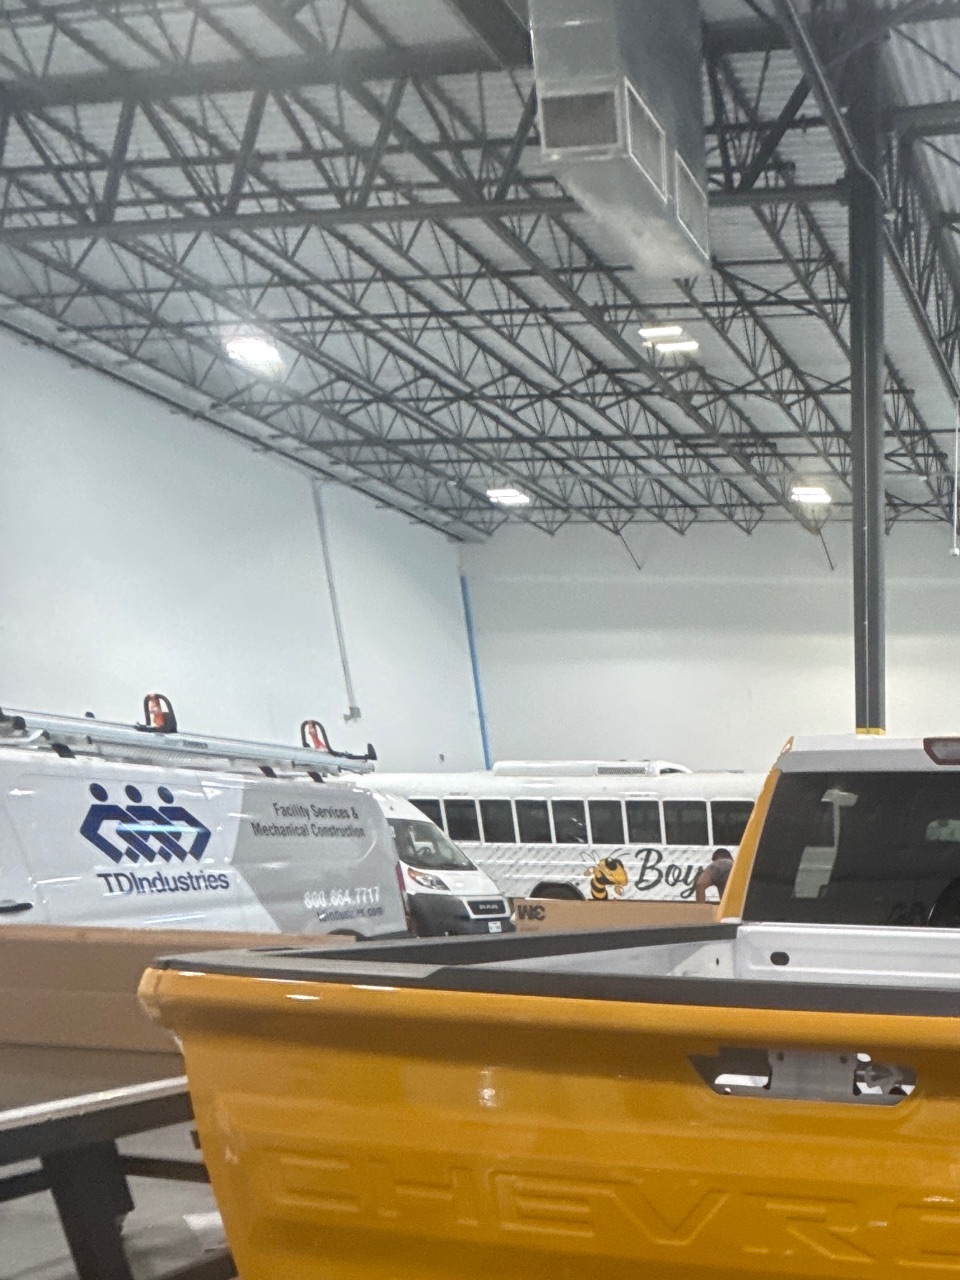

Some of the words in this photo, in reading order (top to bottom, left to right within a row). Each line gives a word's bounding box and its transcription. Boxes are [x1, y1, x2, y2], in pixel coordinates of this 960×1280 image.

[310, 804, 350, 819] Services
[350, 806, 359, 819] &
[251, 822, 309, 837] Mechanical
[310, 823, 366, 838] Construction
[97, 871, 230, 895] TDIndustries
